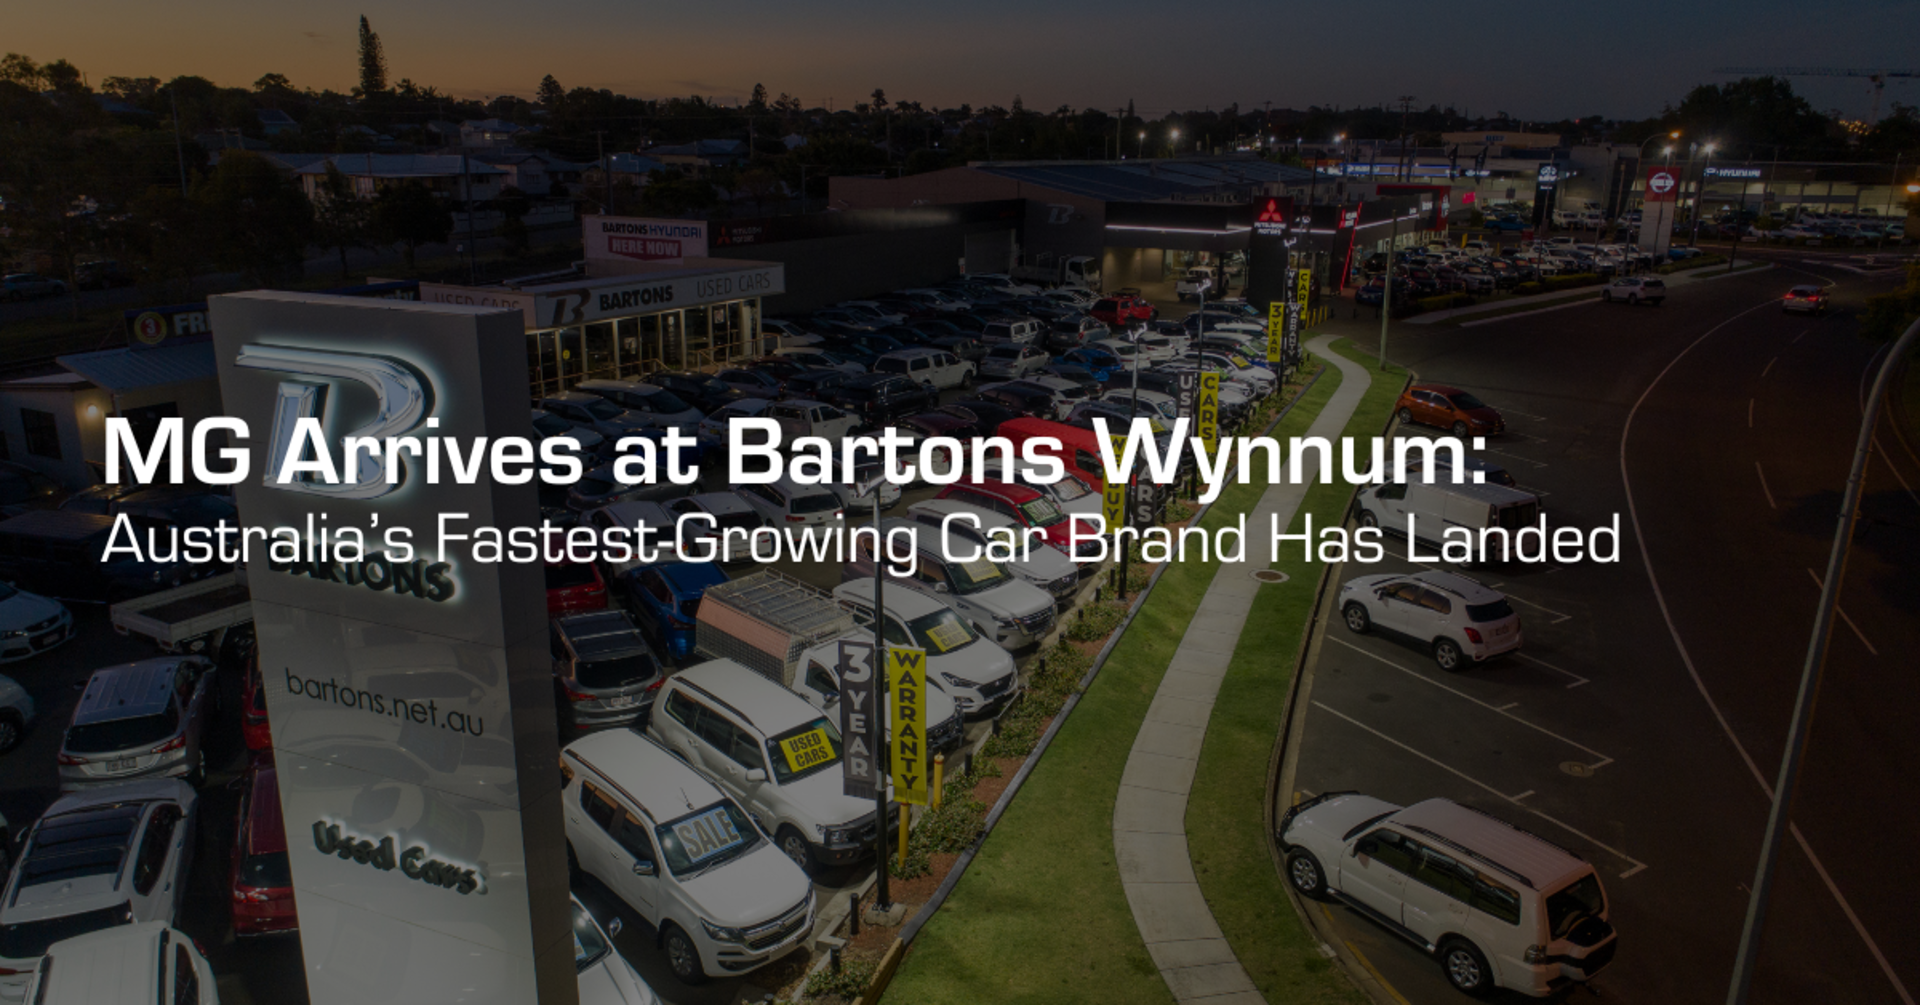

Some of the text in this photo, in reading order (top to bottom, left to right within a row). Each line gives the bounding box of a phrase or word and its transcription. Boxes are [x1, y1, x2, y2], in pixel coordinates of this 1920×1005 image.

[602, 222, 702, 239] BARTONS HYUNDAI
[612, 238, 679, 257] HERE NOW
[599, 284, 674, 311] BARTONS
[697, 277, 732, 298] USED
[739, 271, 771, 292] CARS
[1269, 305, 1282, 354] 3 YEAR
[1202, 376, 1216, 441] CARS
[285, 667, 484, 737] bartons.net.au
[842, 644, 872, 778] 3 YEAR
[893, 651, 922, 790] WARRANTY
[788, 732, 822, 754] USED
[794, 745, 830, 769] CARS
[312, 820, 478, 895] Used Cars
[677, 809, 743, 860] SALE
